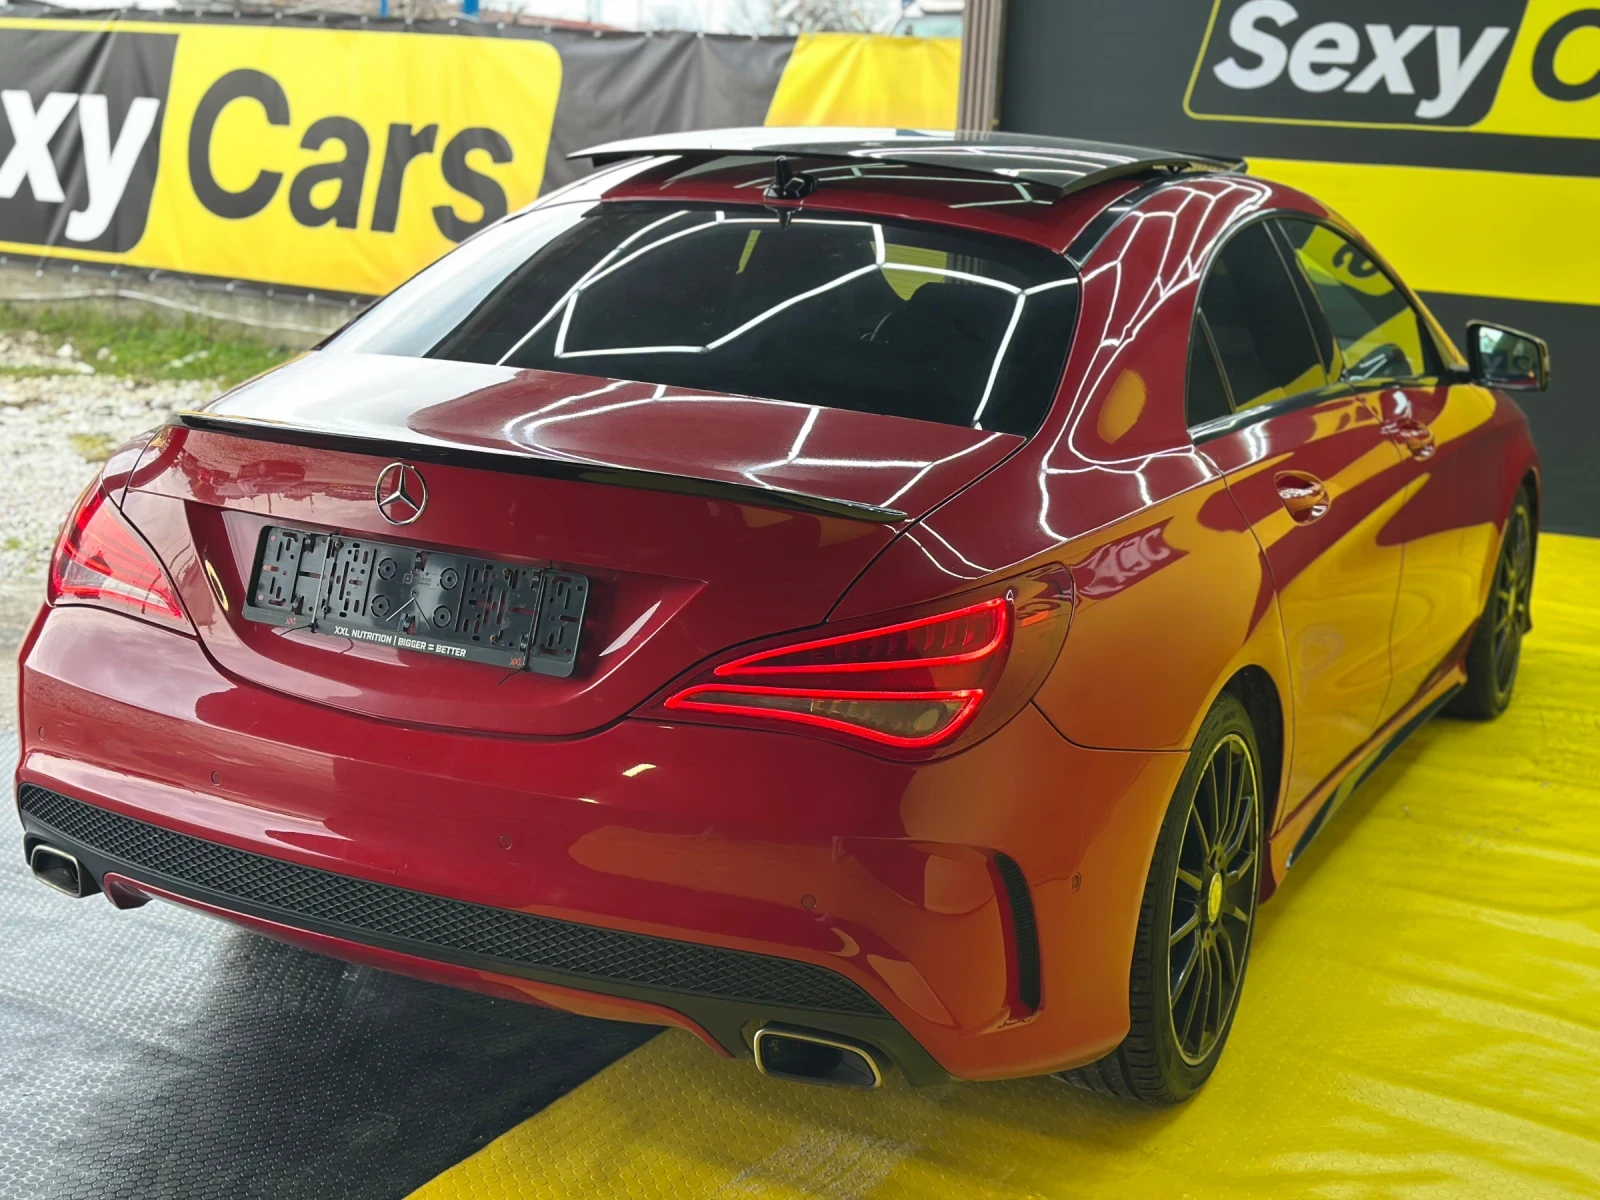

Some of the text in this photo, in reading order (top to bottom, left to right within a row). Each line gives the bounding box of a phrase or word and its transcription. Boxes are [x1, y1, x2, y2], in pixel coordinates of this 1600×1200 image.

[1213, 0, 1511, 119] Sexy
[187, 67, 515, 245] Cars
[333, 625, 350, 637] XXL
[351, 630, 393, 645] NUTRITION
[397, 637, 427, 651] BIGGER
[435, 644, 467, 658] BETTER
